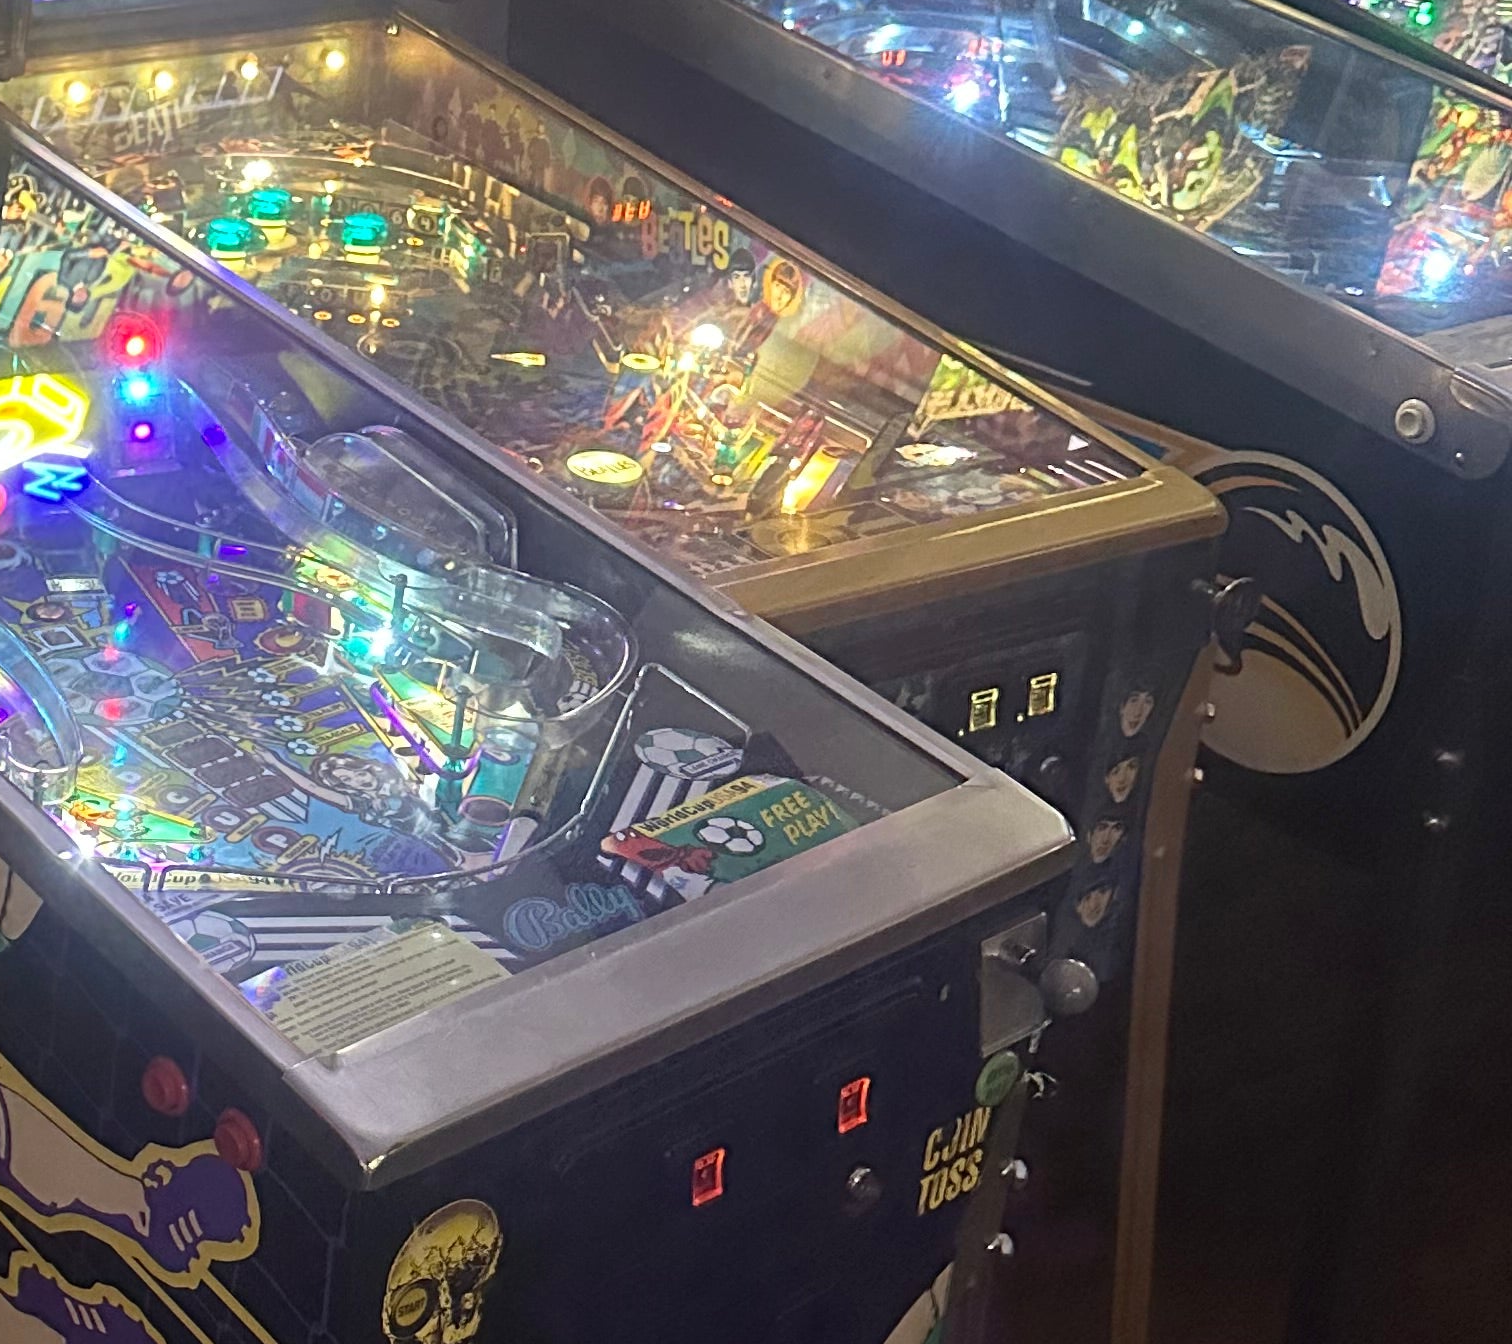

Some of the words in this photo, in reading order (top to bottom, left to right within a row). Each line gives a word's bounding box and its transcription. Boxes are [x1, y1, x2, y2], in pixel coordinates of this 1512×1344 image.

[759, 790, 812, 828] FREE
[152, 892, 192, 912] SAVE
[503, 881, 645, 951] Bally
[917, 1148, 984, 1217] TOSS
[397, 1298, 426, 1318] START
